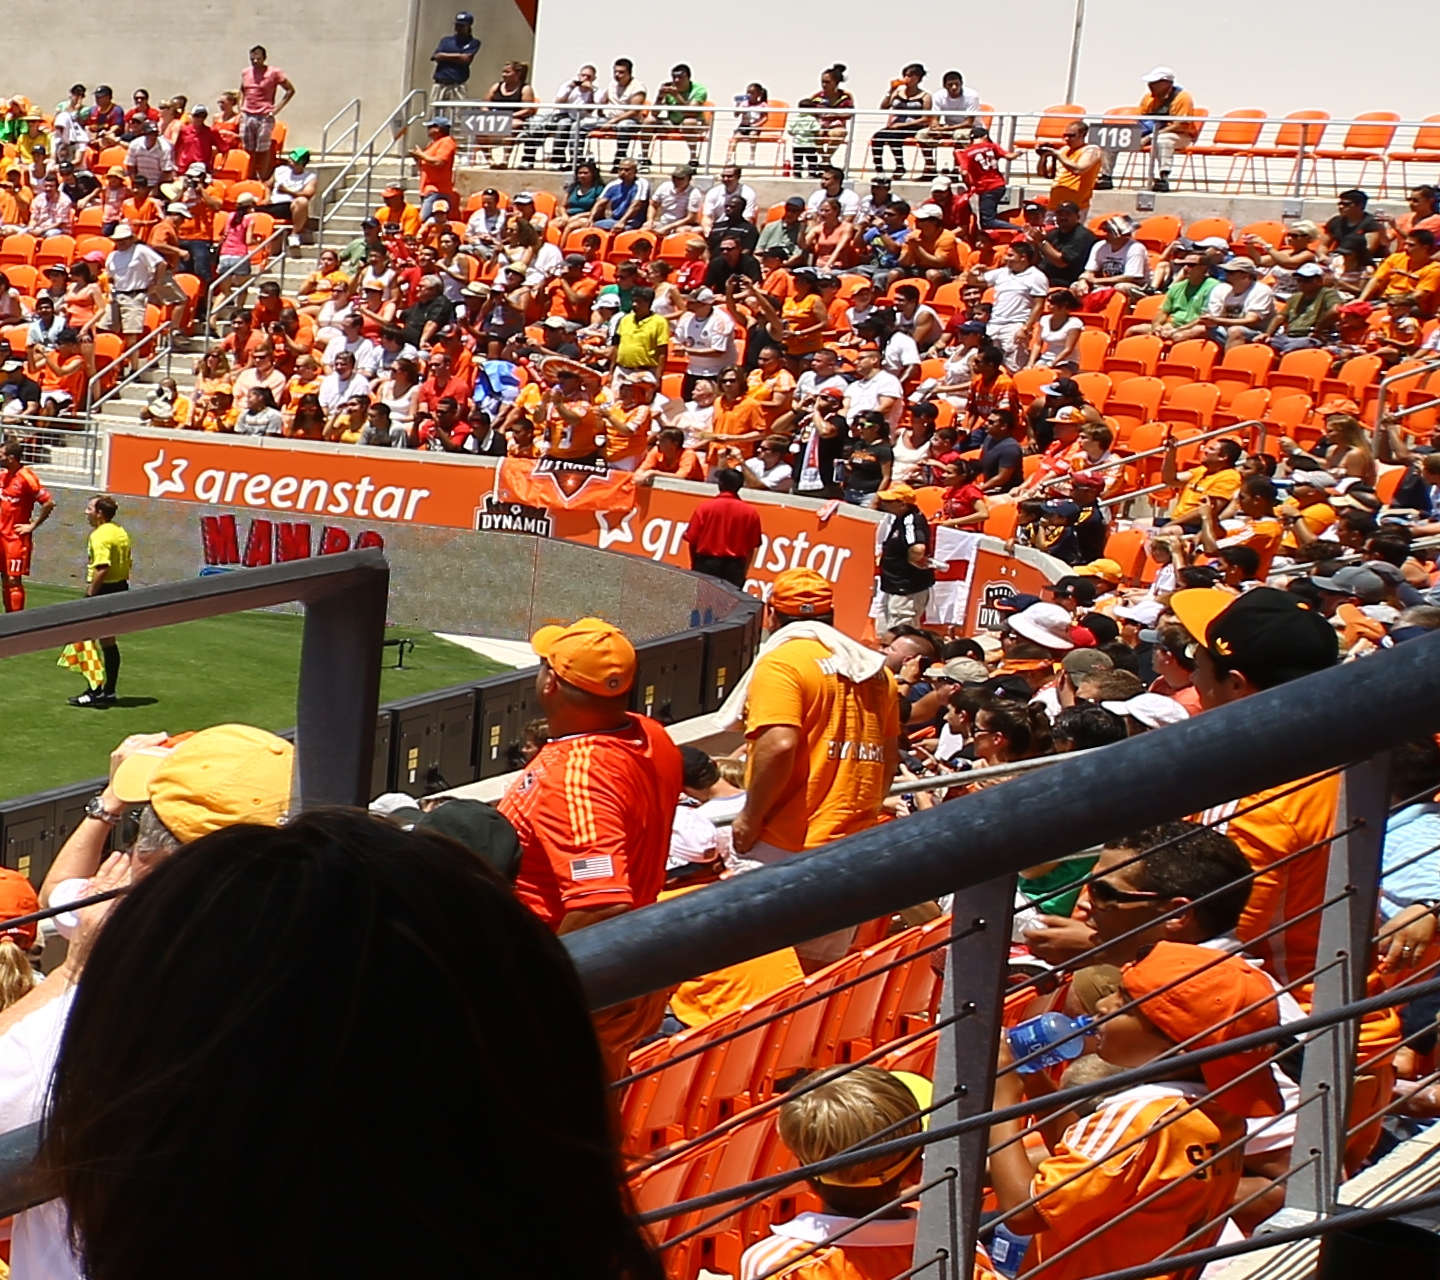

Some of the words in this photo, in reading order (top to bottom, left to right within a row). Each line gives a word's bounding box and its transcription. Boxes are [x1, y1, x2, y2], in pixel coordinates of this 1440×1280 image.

[476, 116, 509, 132] 117
[1097, 128, 1132, 148] 118
[195, 466, 429, 520] greenstar
[482, 514, 549, 535] DYNAMO
